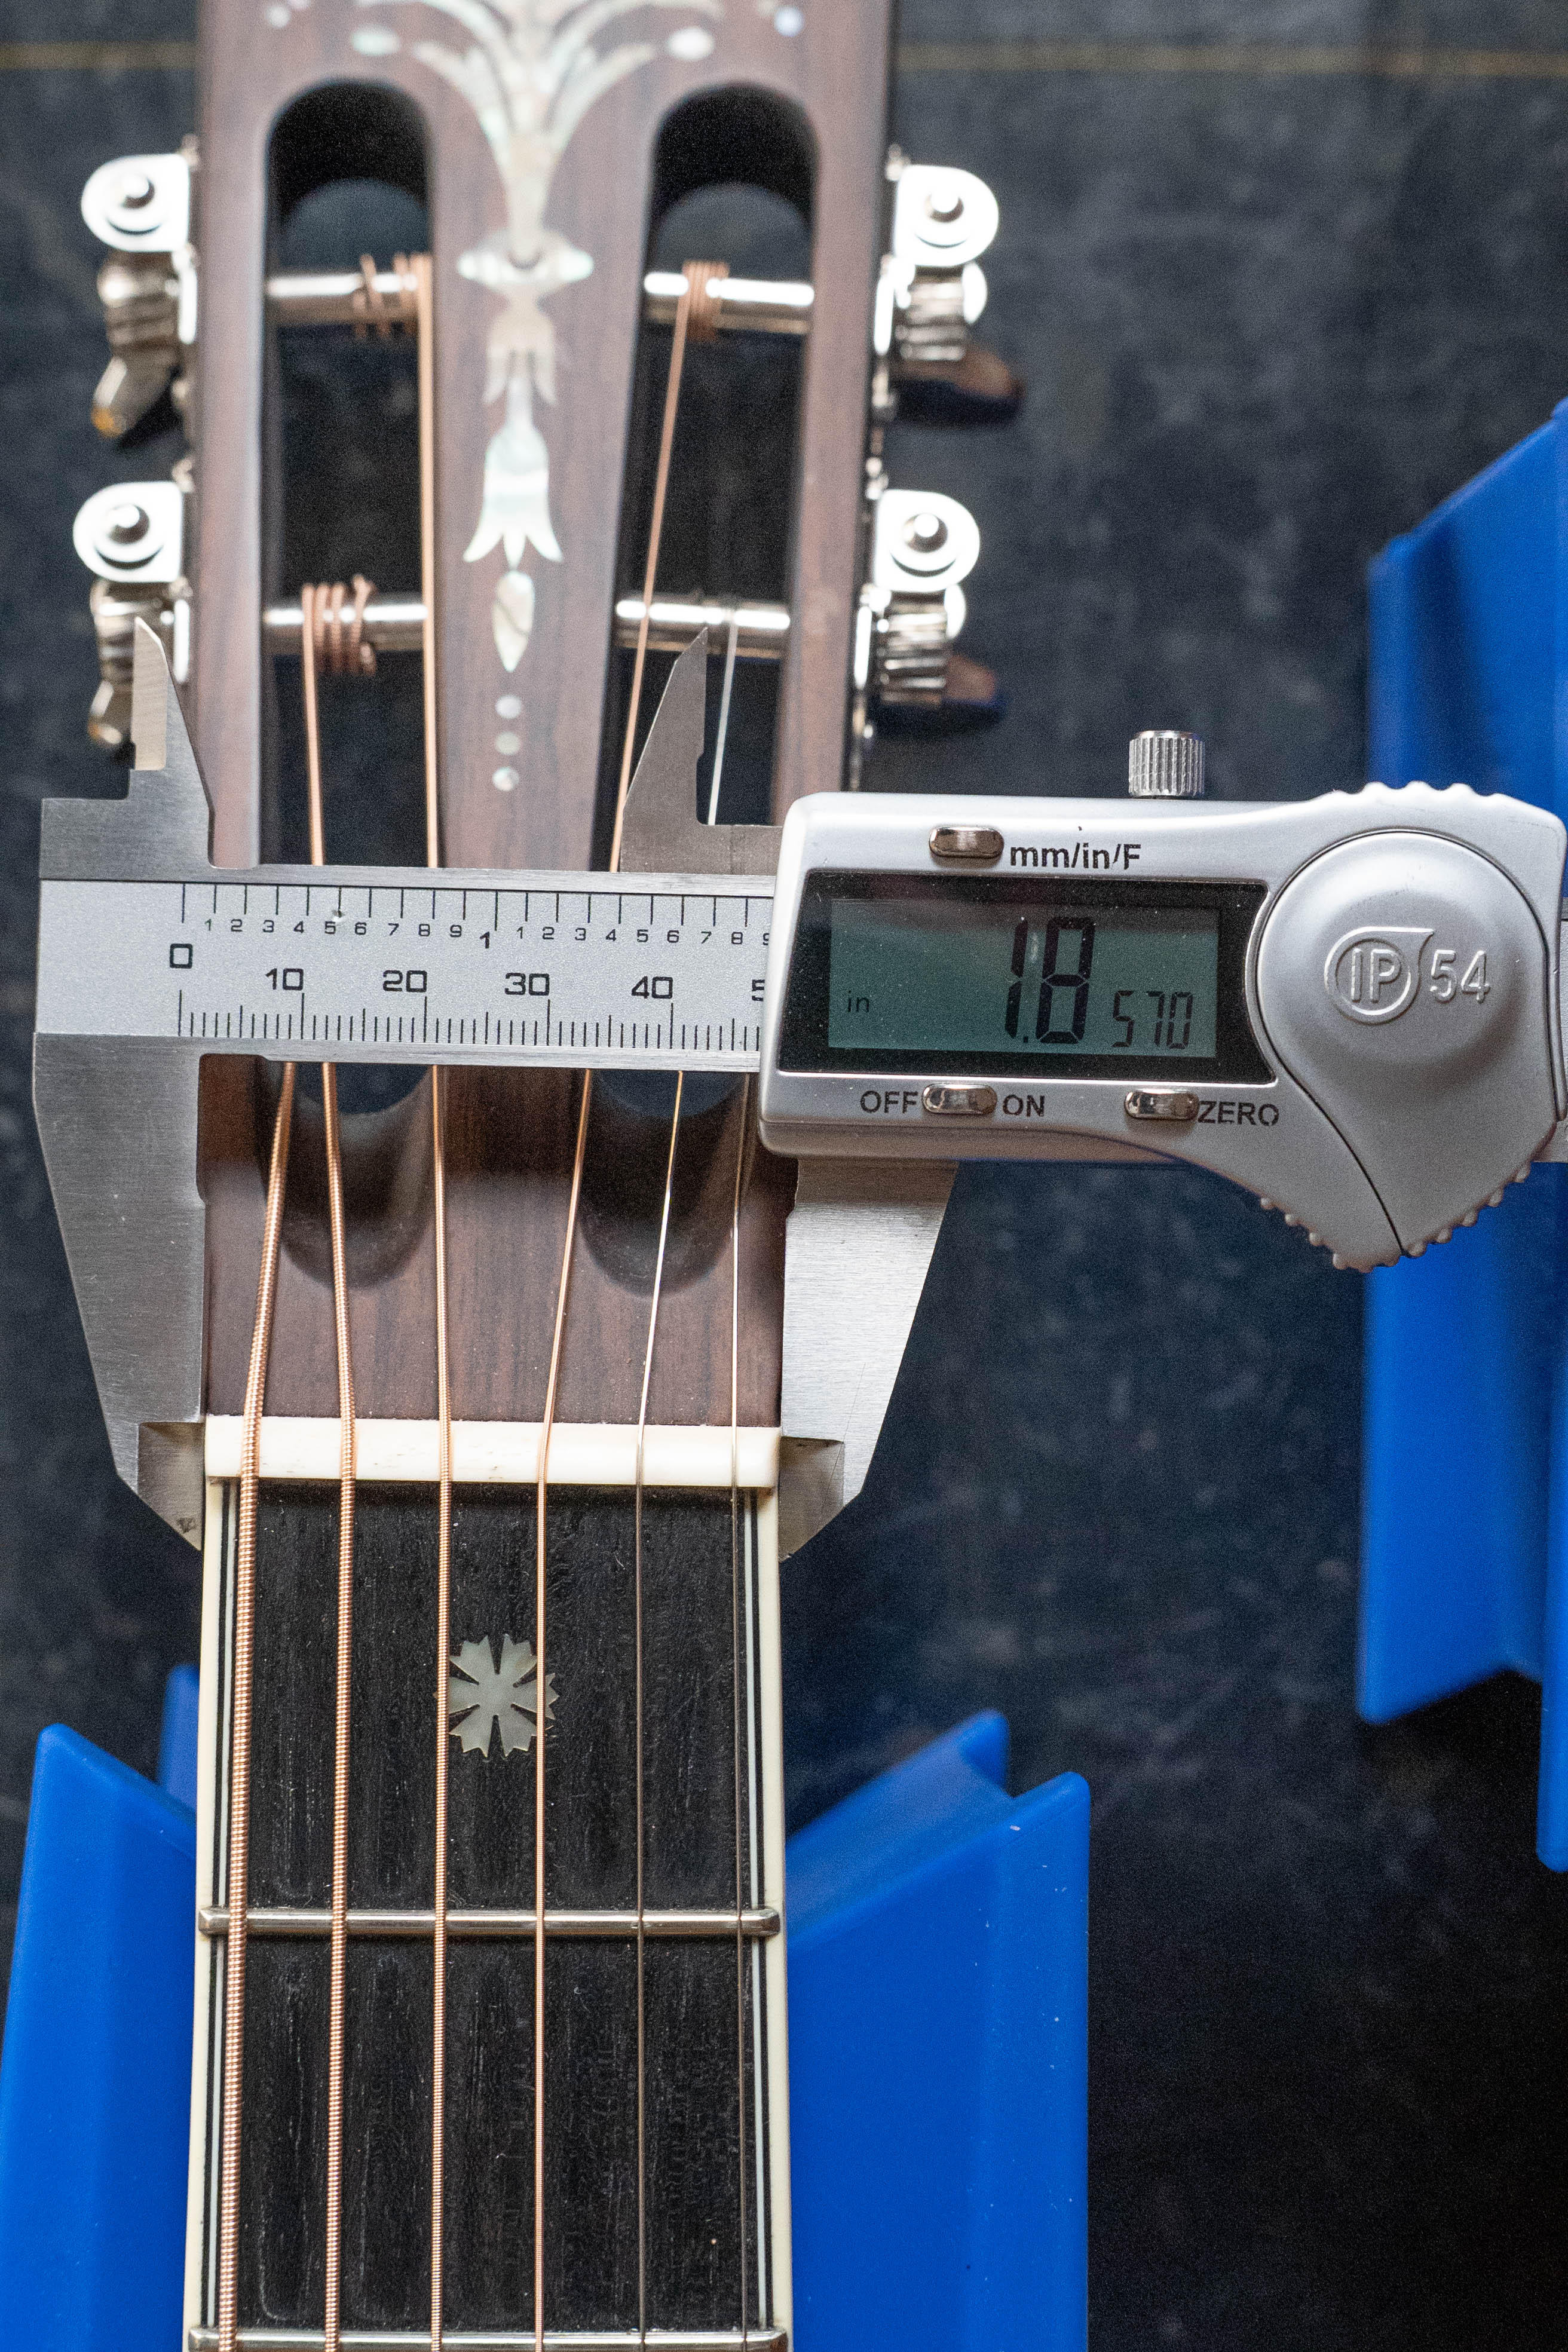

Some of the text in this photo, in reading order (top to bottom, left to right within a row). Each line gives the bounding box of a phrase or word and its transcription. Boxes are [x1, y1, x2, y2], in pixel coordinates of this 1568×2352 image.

[1010, 842, 1141, 870] mm/in/F
[206, 918, 212, 931] 1
[231, 918, 243, 932] 2
[262, 919, 274, 933] 3
[293, 921, 304, 933] 4
[324, 921, 336, 935] 5
[354, 921, 367, 936] 6
[388, 923, 399, 936] 7
[418, 923, 431, 937] 8
[449, 924, 463, 938] 9
[479, 931, 490, 949] 1
[517, 926, 523, 939] 1
[542, 926, 555, 940] 2
[574, 927, 586, 941] 3
[605, 929, 617, 942] 4
[636, 929, 648, 943] 5
[667, 930, 679, 944] 6
[701, 931, 712, 944] 7
[731, 932, 743, 945] 8
[169, 943, 194, 969] 0
[265, 967, 304, 991] 10
[382, 970, 428, 993] 20
[504, 972, 550, 996] 30
[631, 976, 673, 1000] 40
[1350, 947, 1491, 1005] IP 54
[846, 991, 871, 1013] in
[859, 1089, 1046, 1118] OFF ON
[1196, 1100, 1281, 1128] ZERO
